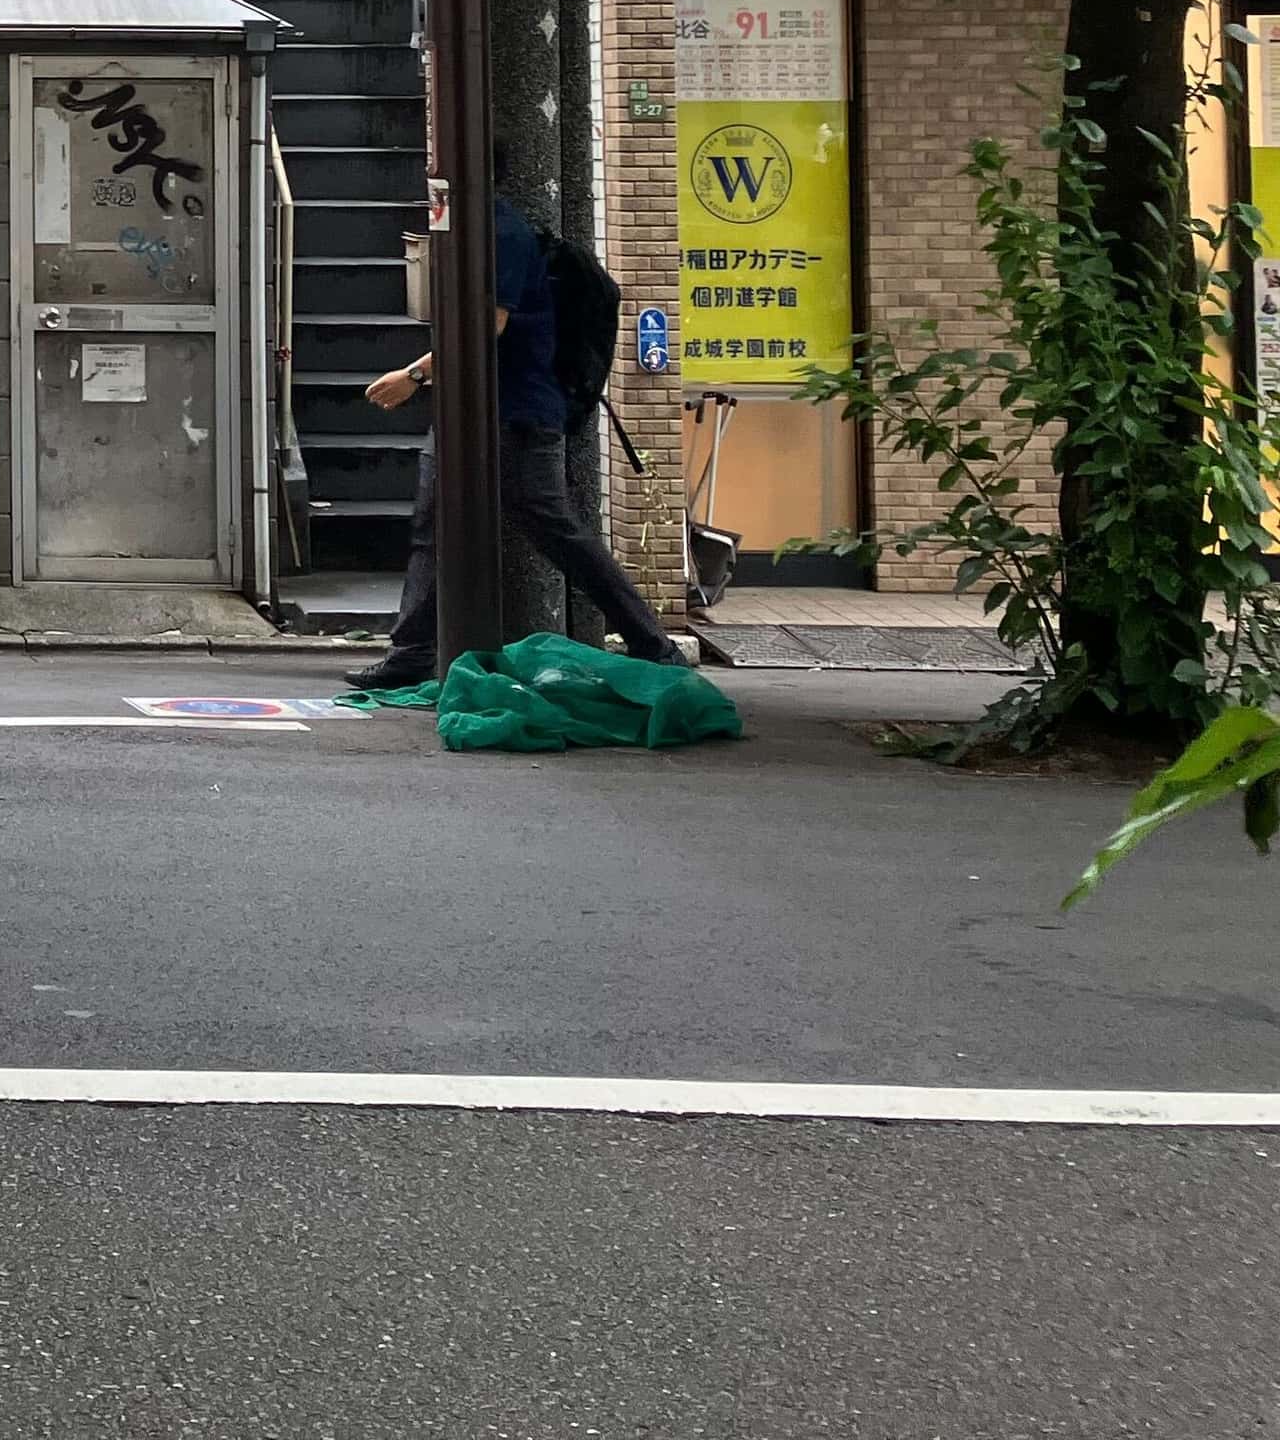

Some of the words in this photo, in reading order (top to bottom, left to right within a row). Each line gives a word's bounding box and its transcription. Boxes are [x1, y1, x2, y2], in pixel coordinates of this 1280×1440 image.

[736, 11, 769, 40] 91
[634, 104, 663, 116] 5-27
[705, 156, 777, 203] W
[690, 286, 798, 308] 個別進学館
[684, 338, 807, 359] 成城学園前校
